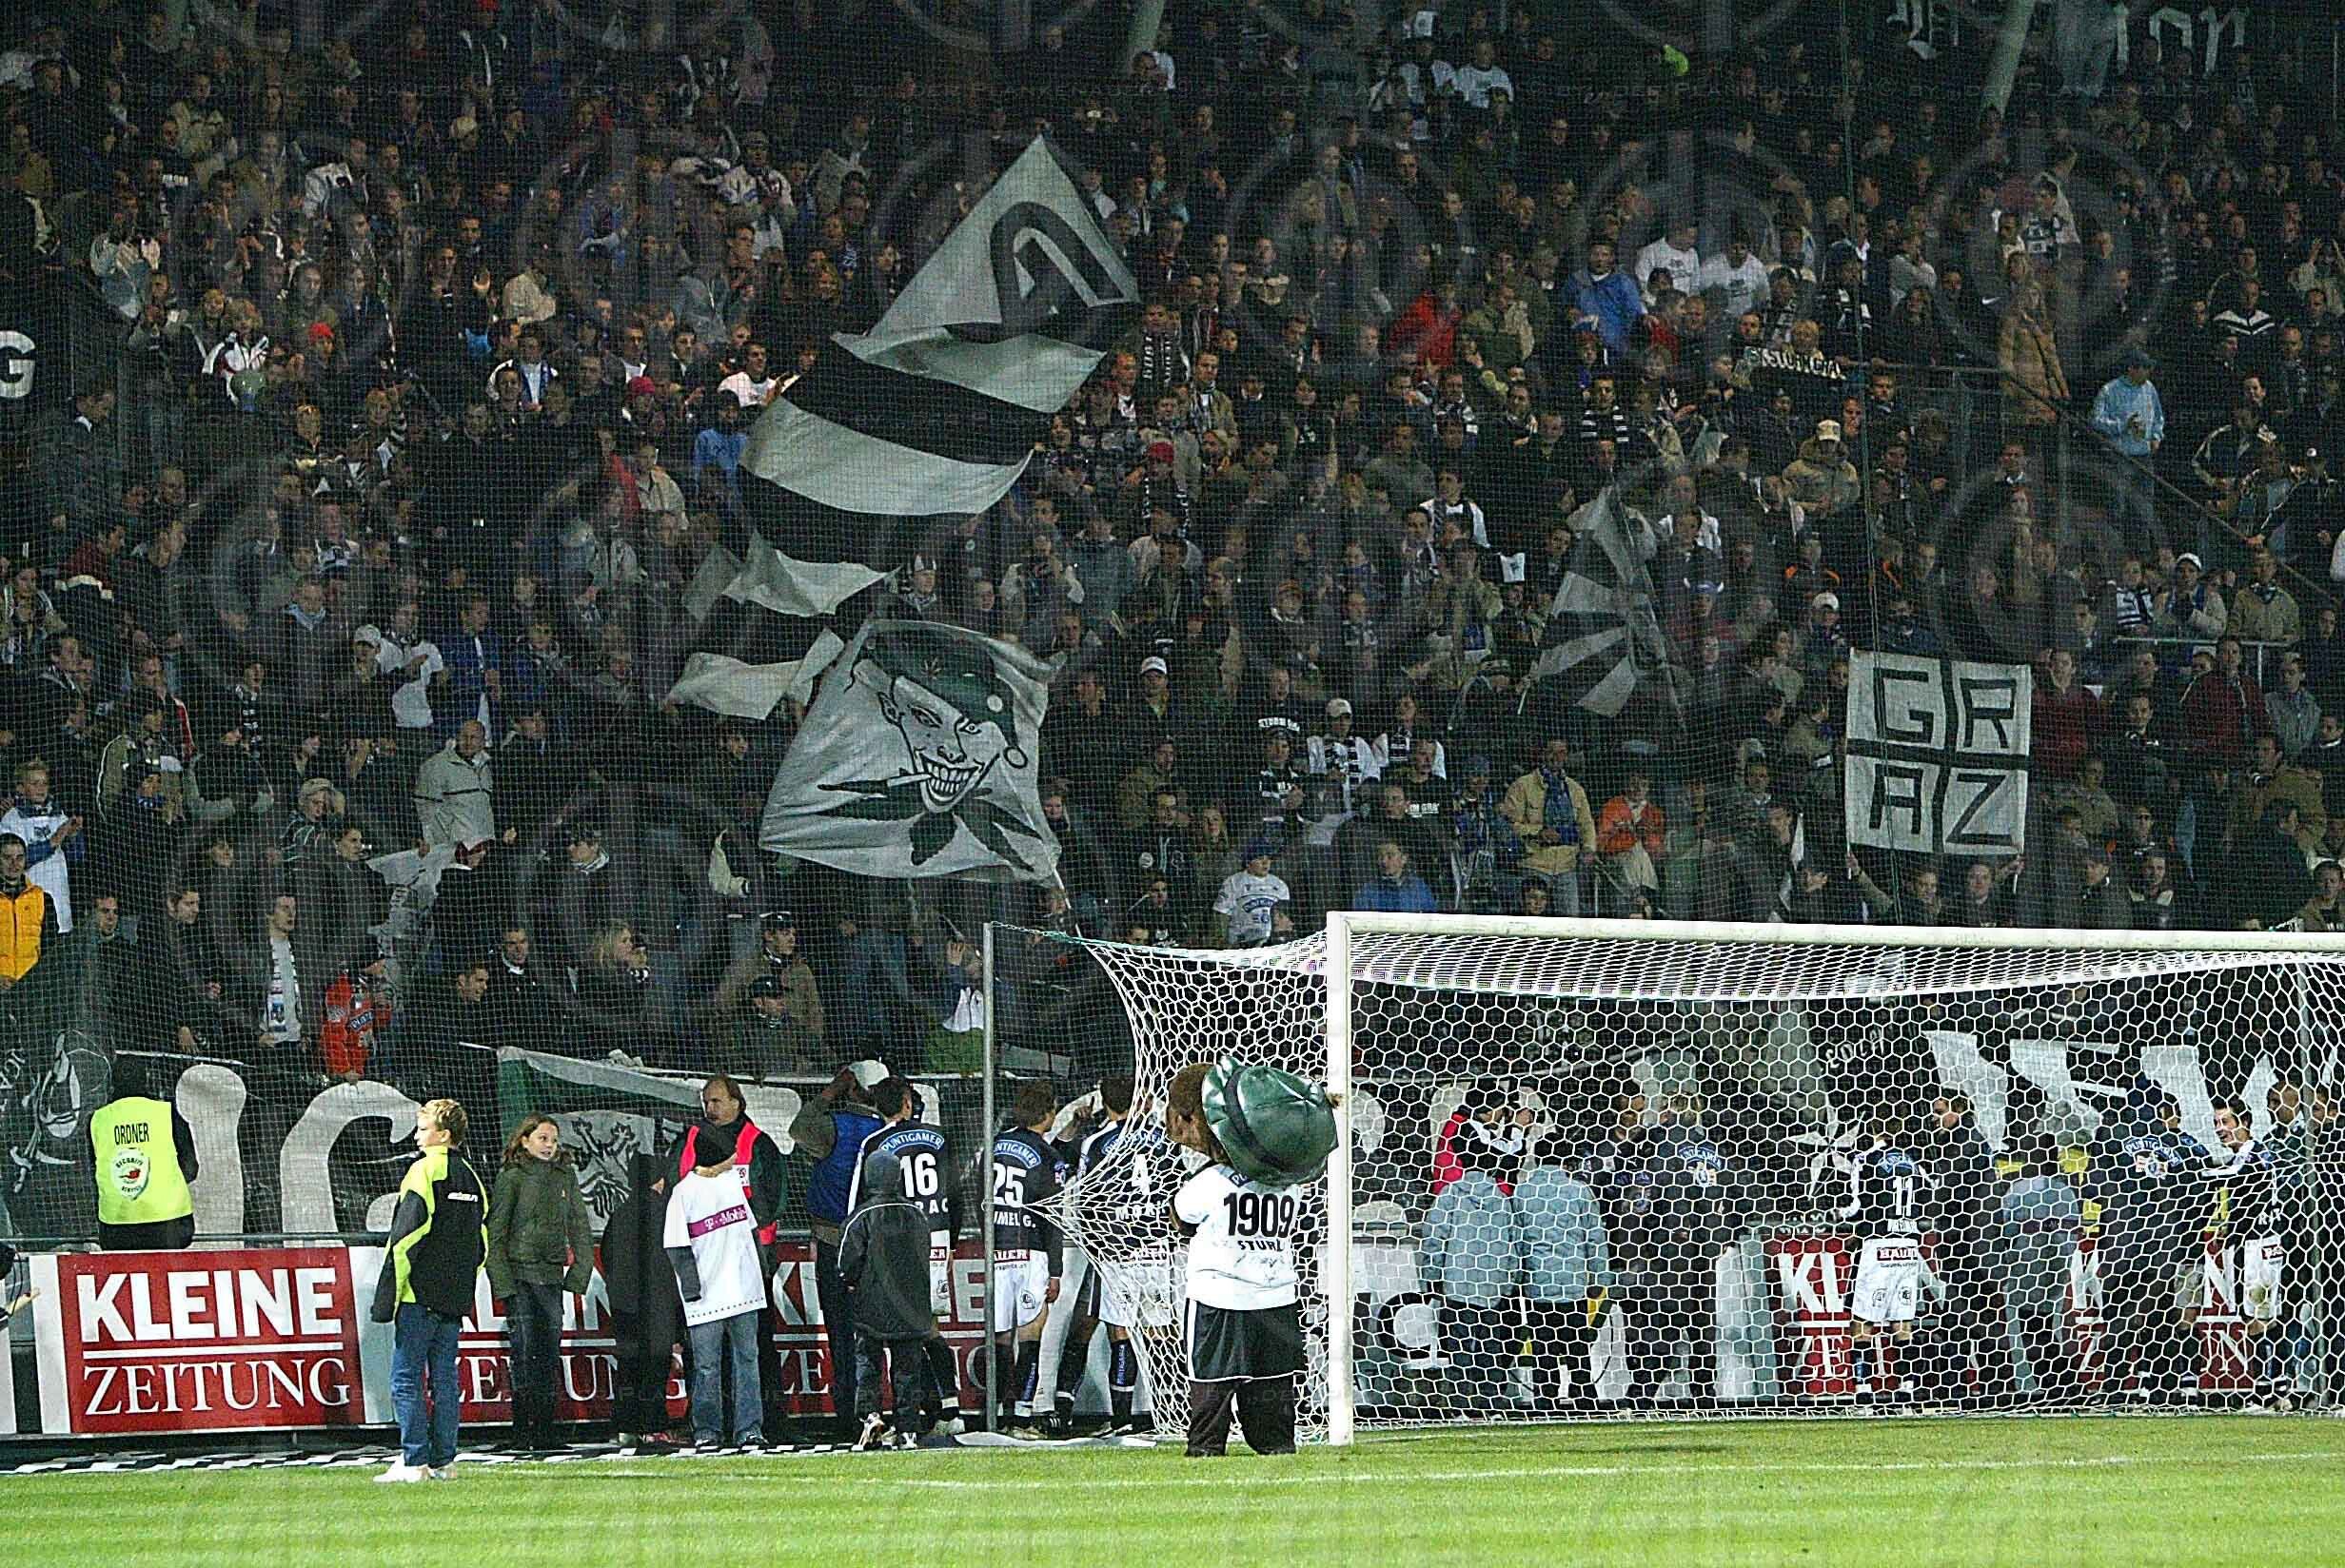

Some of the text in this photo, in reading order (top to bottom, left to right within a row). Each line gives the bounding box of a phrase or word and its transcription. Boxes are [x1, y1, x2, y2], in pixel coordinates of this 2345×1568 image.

[114, 1123, 149, 1146] ORDNER
[899, 1152, 938, 1198] 16
[993, 1162, 1028, 1208] 25
[1223, 1191, 1295, 1239] 1909
[78, 1268, 343, 1343] KLEINE
[83, 1358, 350, 1416] ZEITUNG
